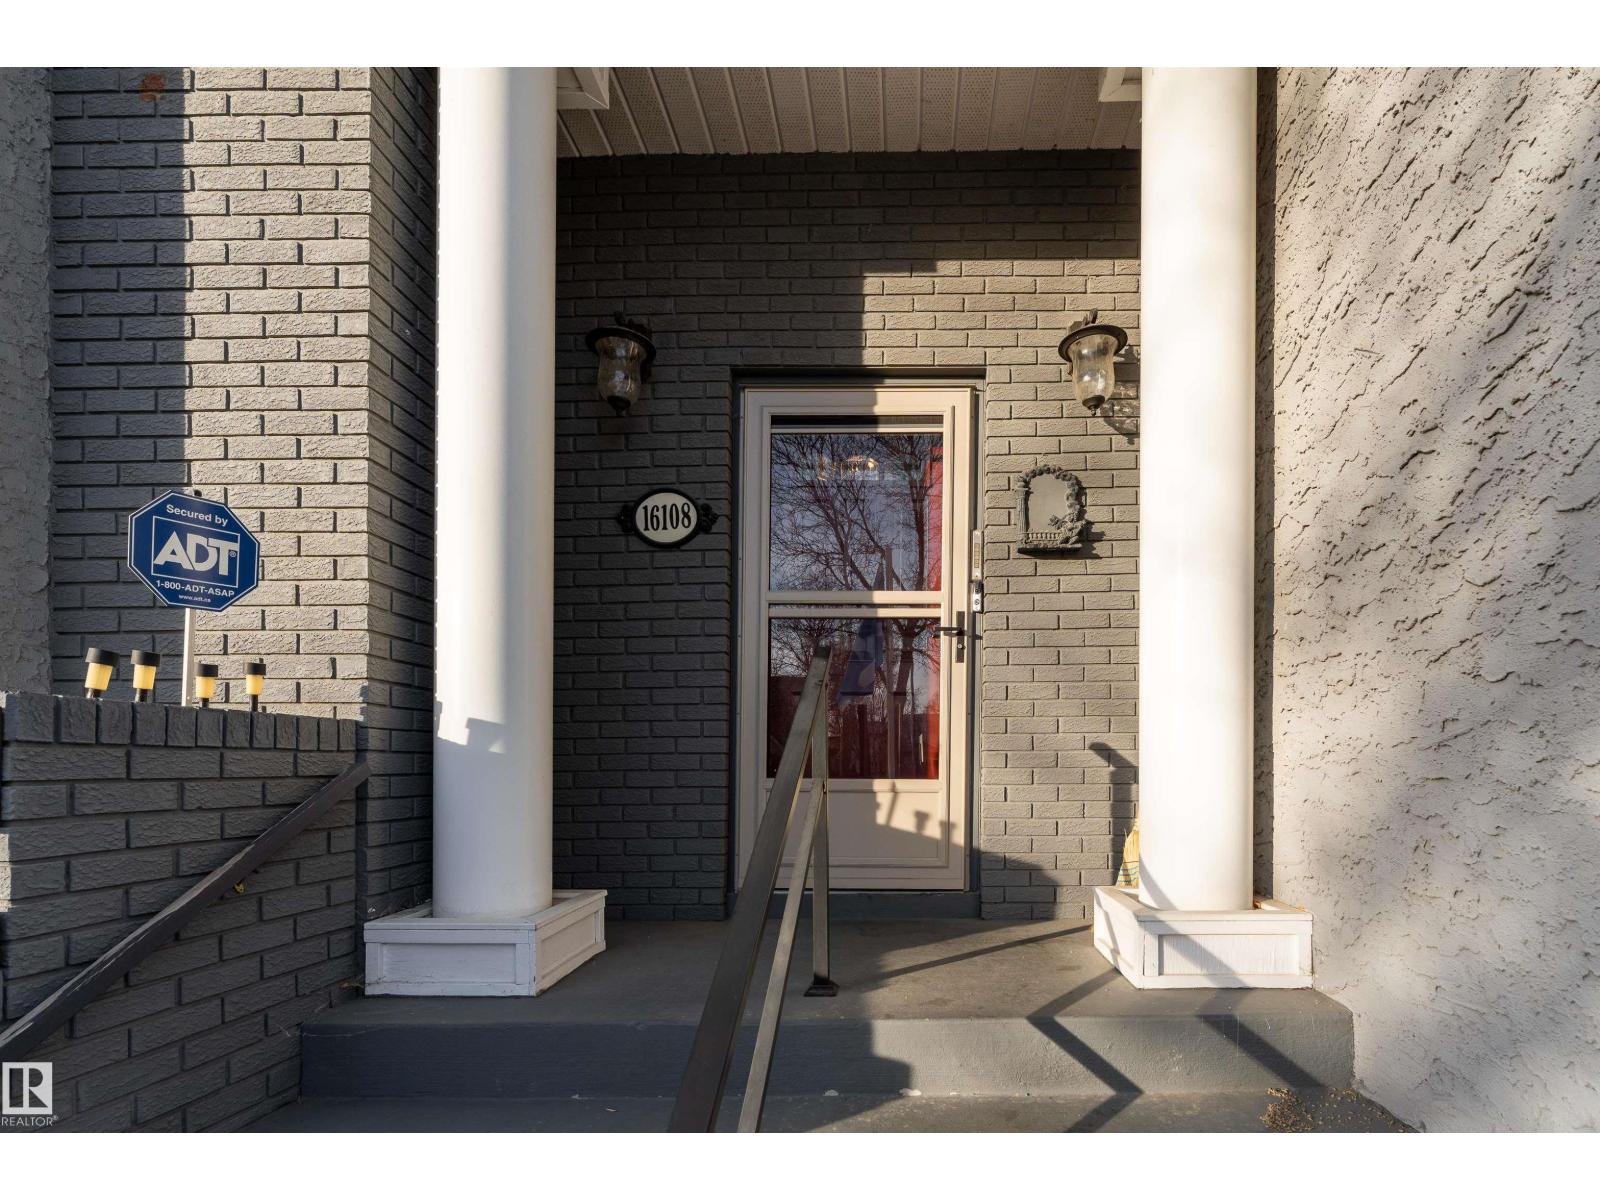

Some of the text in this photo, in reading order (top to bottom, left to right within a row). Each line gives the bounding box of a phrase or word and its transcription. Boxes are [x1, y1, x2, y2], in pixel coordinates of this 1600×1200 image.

[166, 503, 229, 528] Secured by
[642, 502, 692, 532] 16108
[155, 579, 235, 598] 1-800-ADT-ASAP
